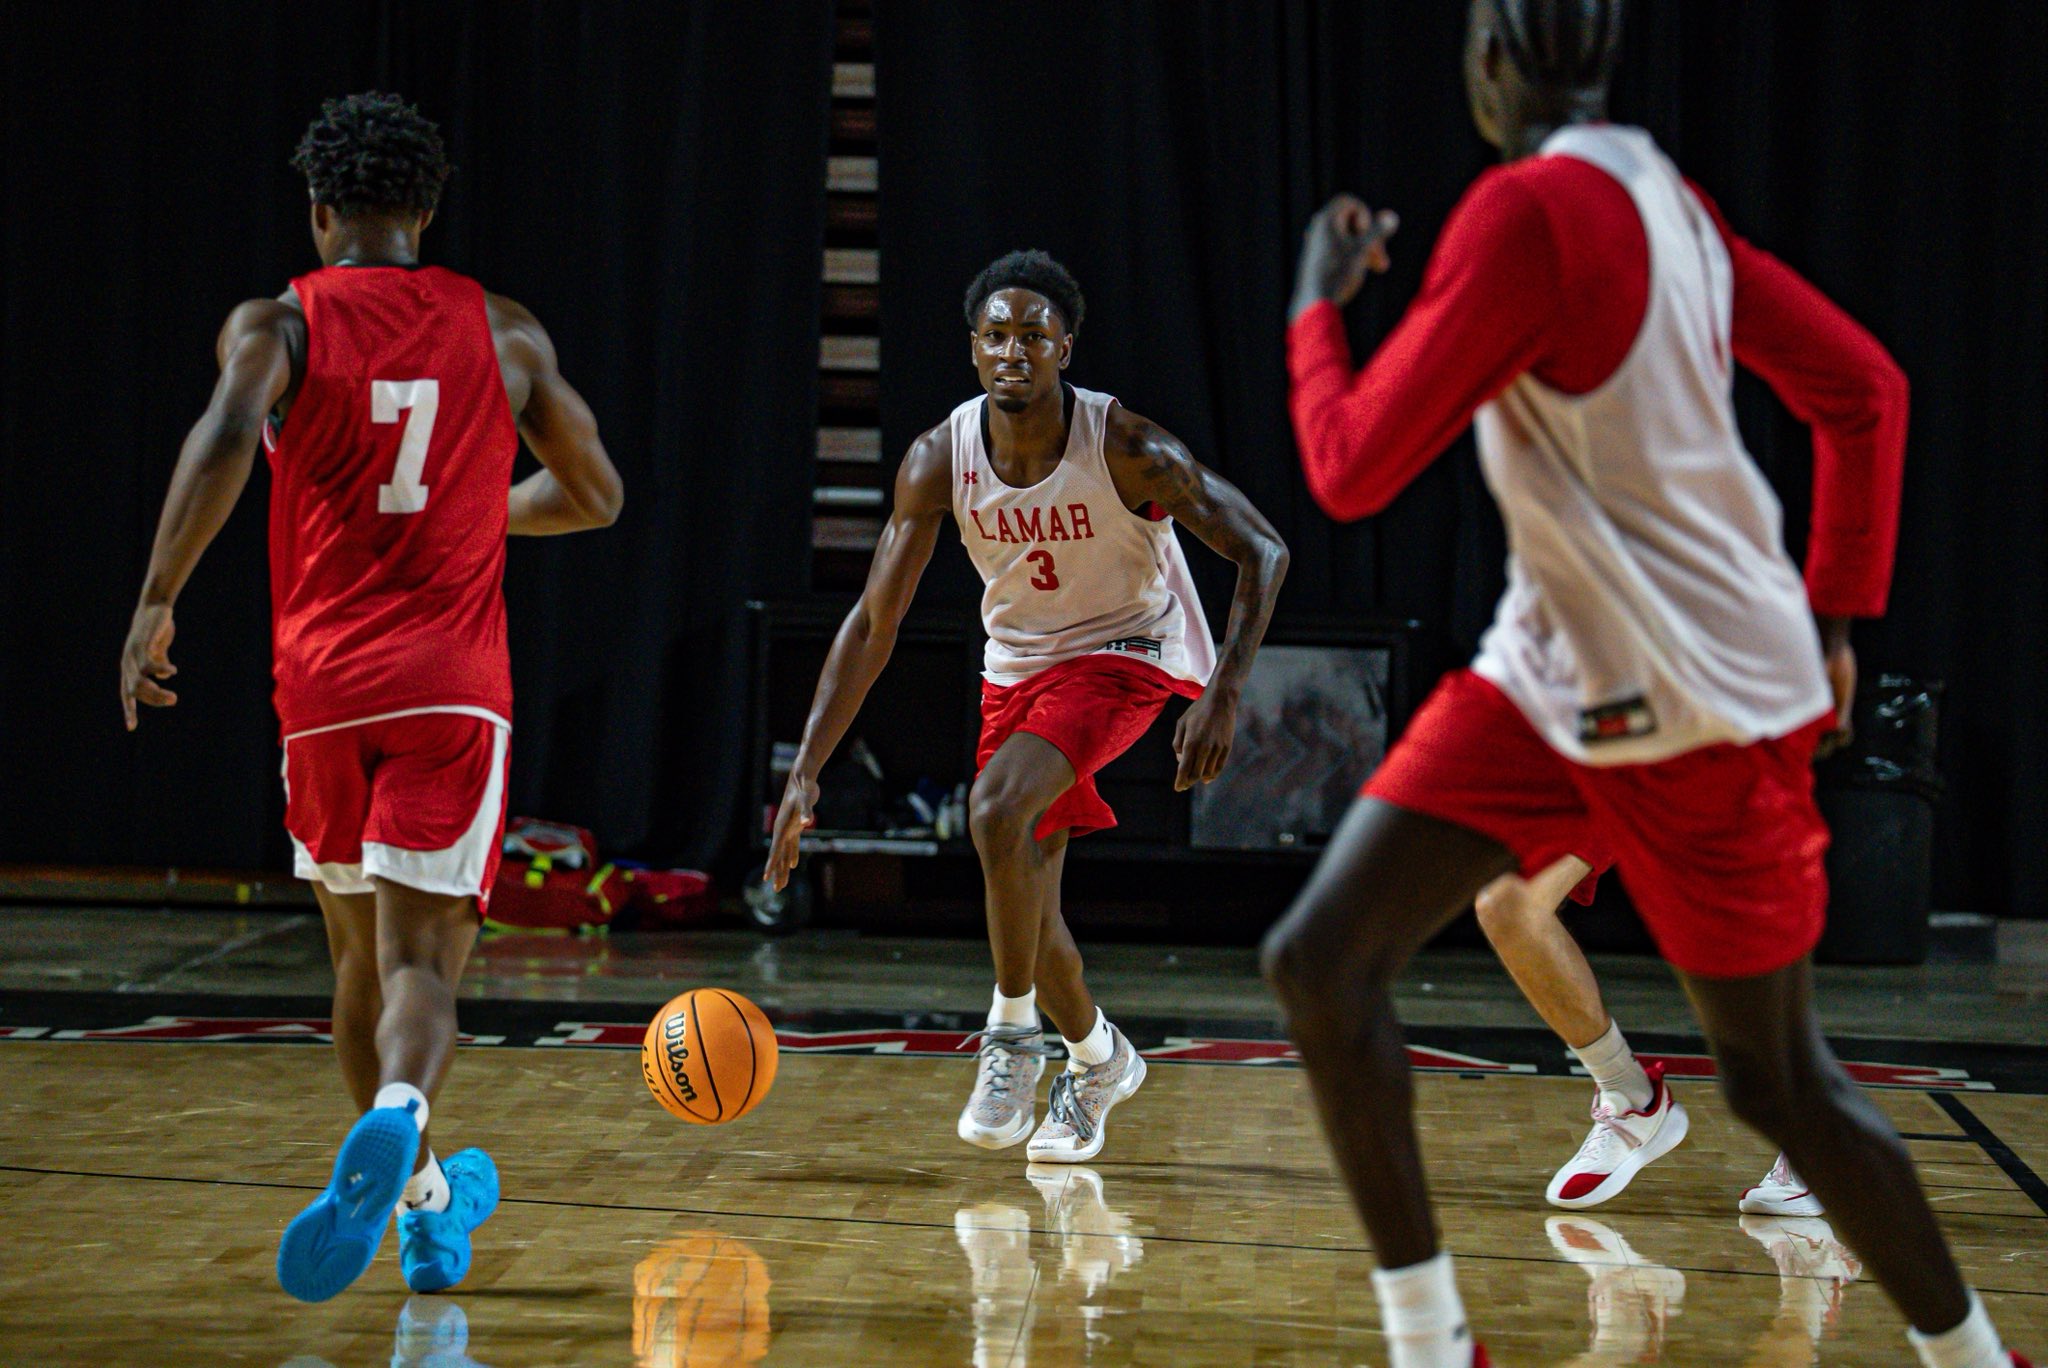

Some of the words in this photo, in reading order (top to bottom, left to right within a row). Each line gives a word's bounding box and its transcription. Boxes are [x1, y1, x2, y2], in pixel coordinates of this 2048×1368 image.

[370, 378, 439, 514] 7
[971, 503, 1095, 543] LAMAR
[1026, 550, 1060, 591] 3
[664, 1010, 698, 1102] Wilson
